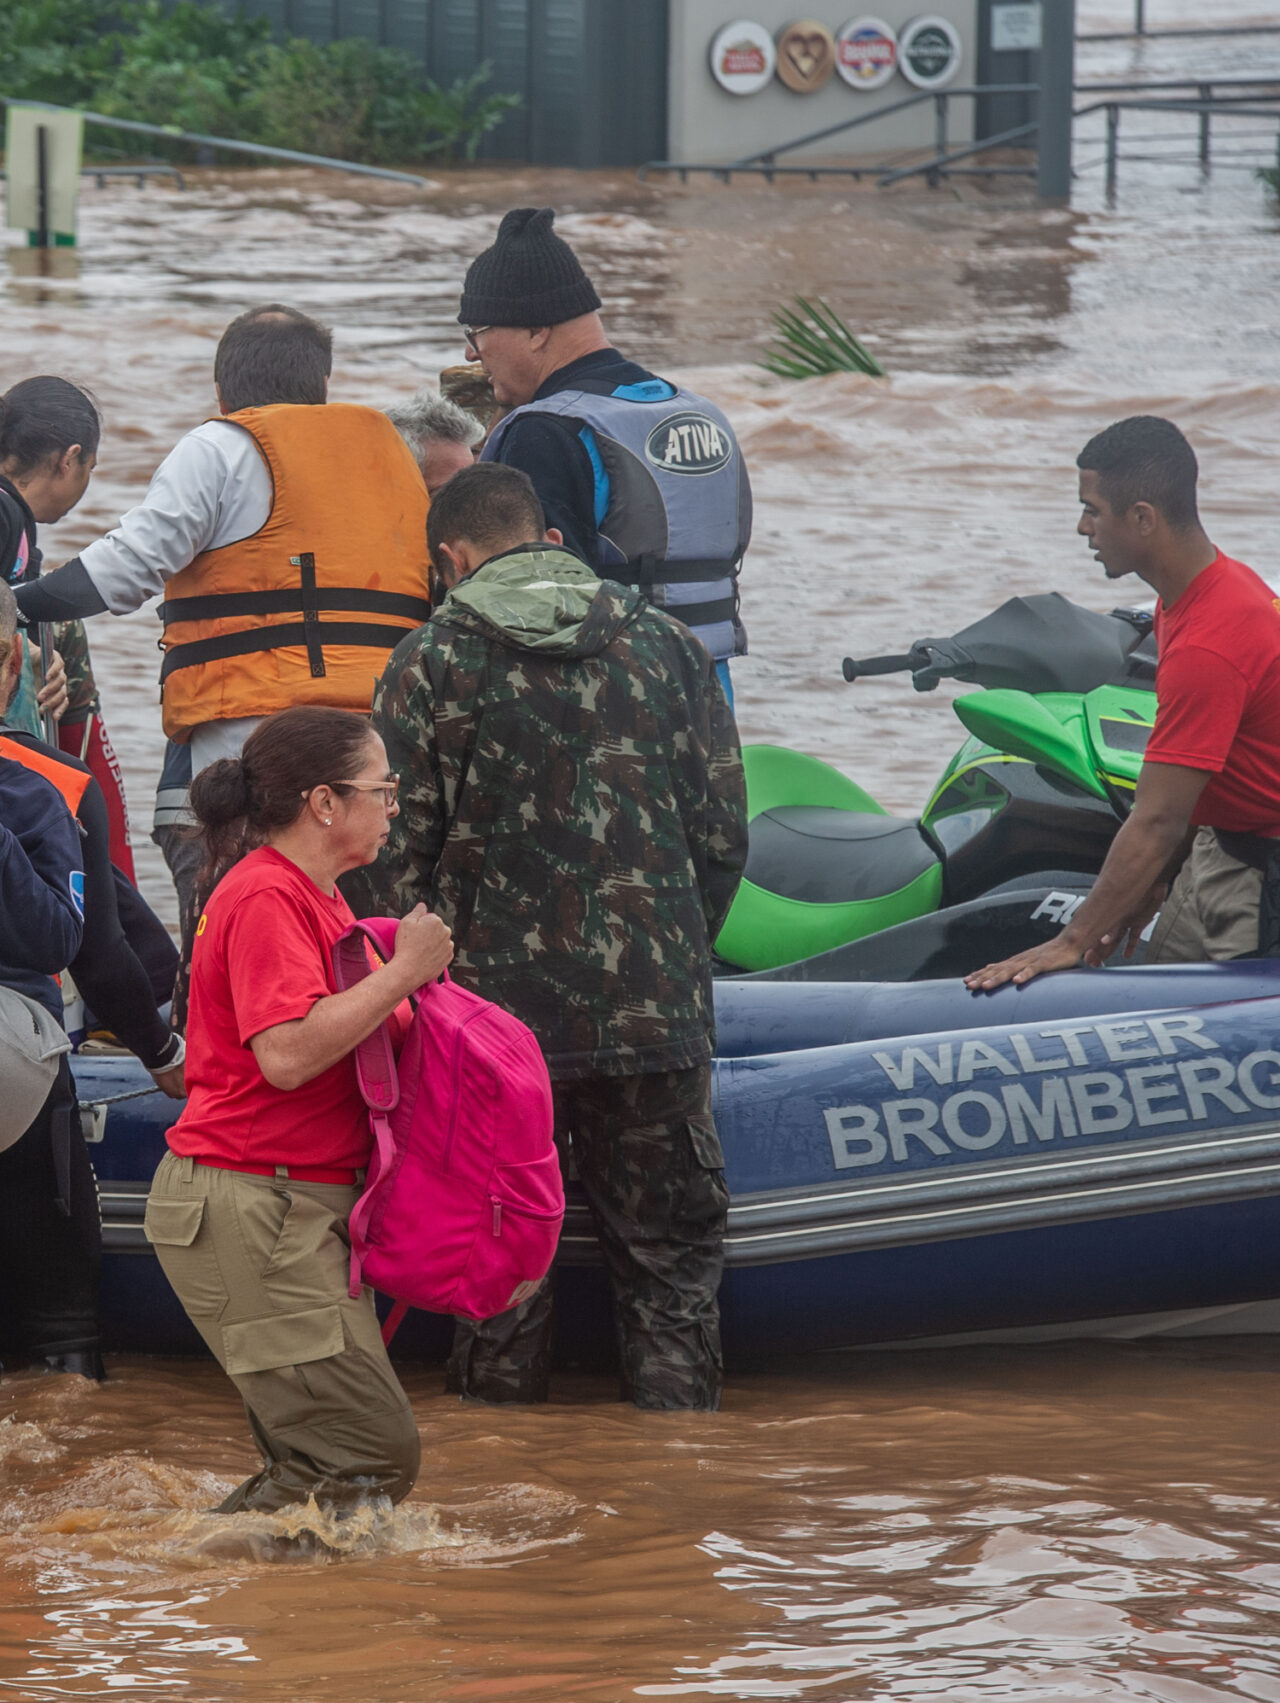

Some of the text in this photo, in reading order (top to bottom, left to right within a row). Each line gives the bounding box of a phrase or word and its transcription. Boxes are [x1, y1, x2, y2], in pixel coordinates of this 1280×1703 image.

[664, 423, 724, 464] ATIVA
[871, 1014, 1220, 1091] WALTER
[822, 1050, 1280, 1170] BROMBERG
